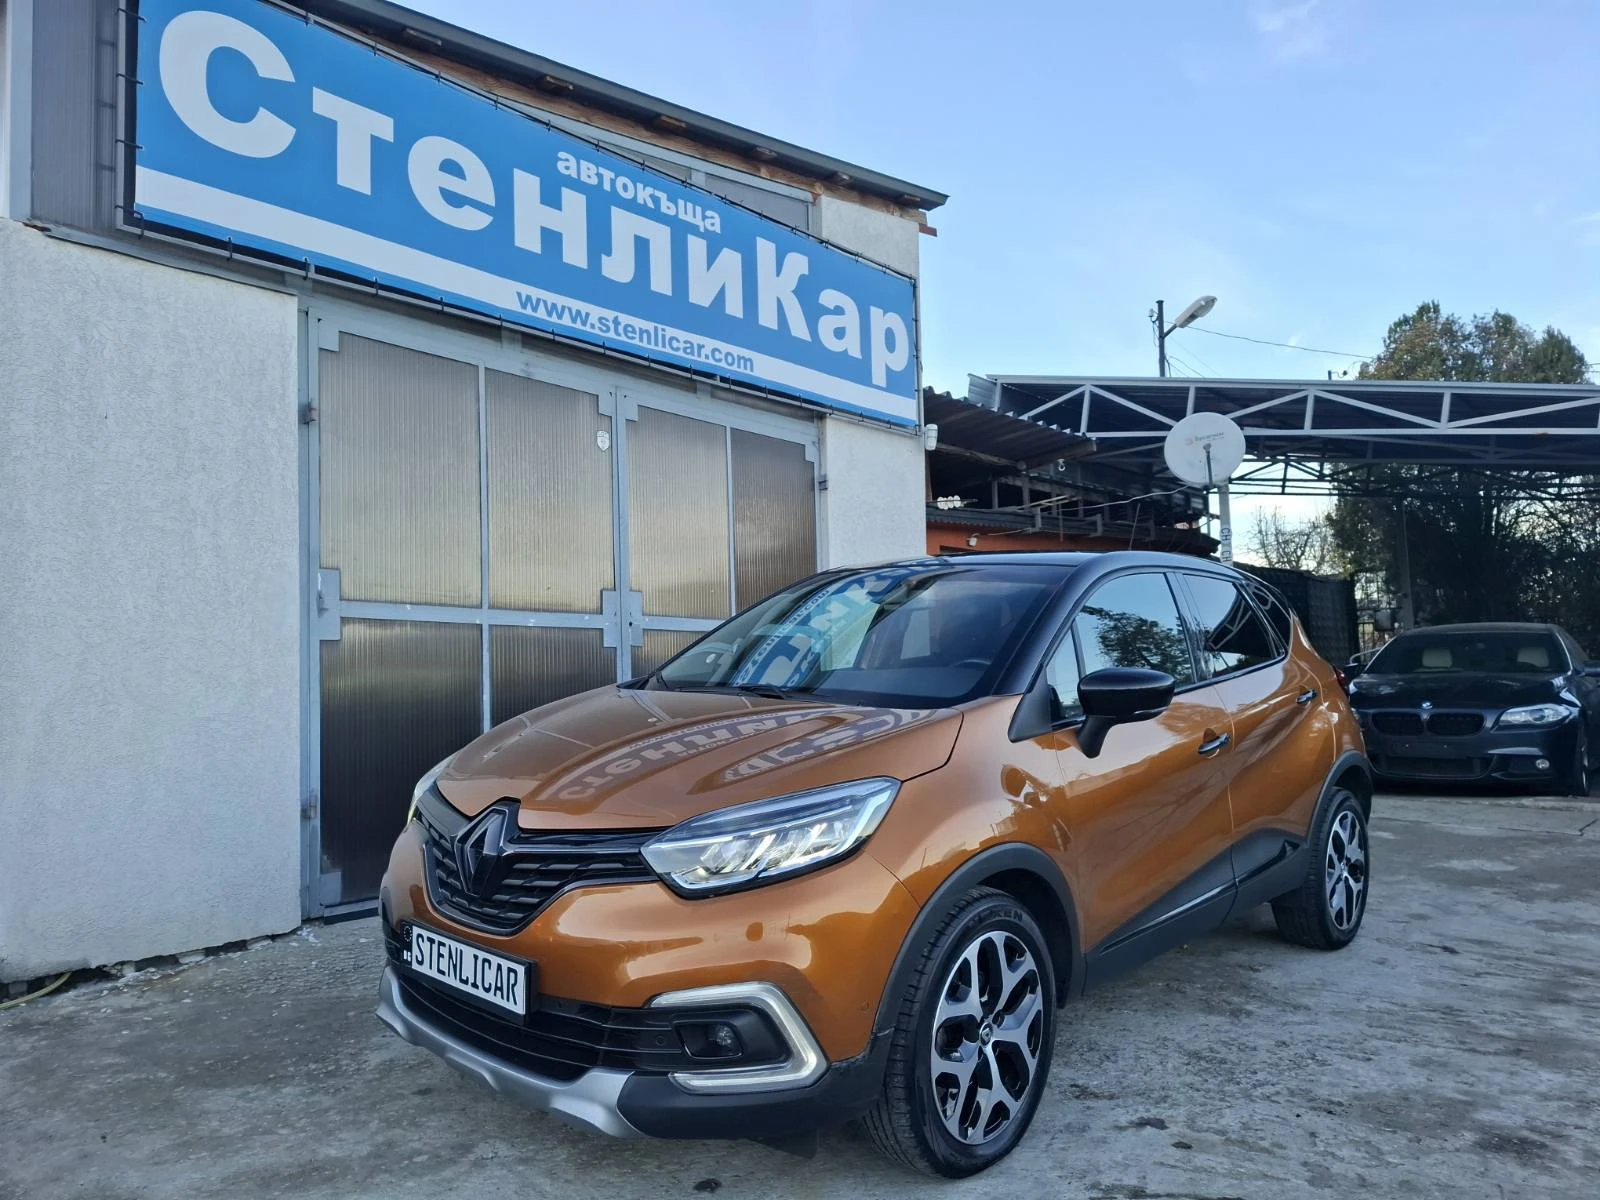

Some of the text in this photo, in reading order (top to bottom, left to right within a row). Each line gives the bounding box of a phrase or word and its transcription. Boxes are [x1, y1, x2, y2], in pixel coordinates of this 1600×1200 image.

[159, 10, 909, 388] СтенлиКар
[557, 151, 721, 234] автокъща
[516, 291, 755, 373] www.stenlicar.com
[415, 933, 518, 1006] STENLICAR
